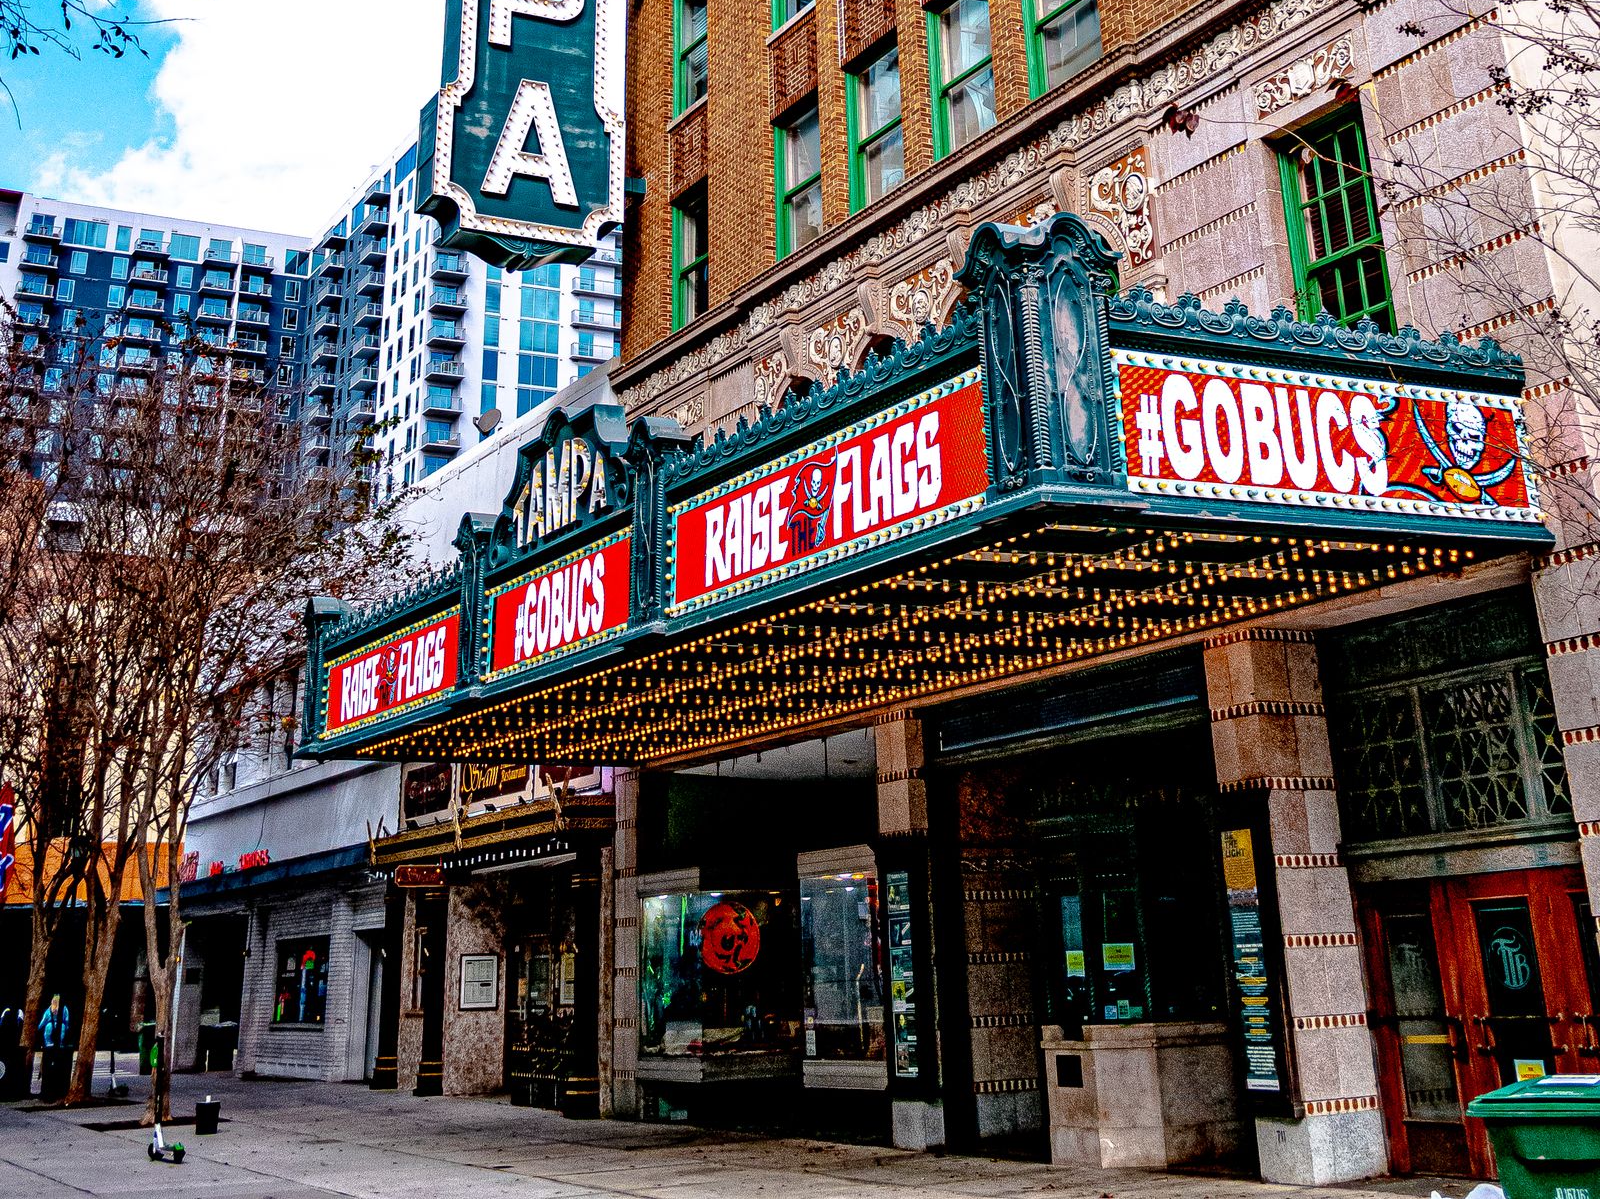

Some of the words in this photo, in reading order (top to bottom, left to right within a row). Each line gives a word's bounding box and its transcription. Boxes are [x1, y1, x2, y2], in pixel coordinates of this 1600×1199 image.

[1135, 374, 1389, 497] #GOBUCS
[512, 437, 607, 549] TAMPA
[704, 474, 790, 588] RAISE
[788, 517, 816, 556] THE
[832, 410, 942, 540] FLAGS
[514, 552, 605, 662] #GOBUCS
[340, 653, 381, 723] RAISE
[396, 626, 447, 702] FLAGS
